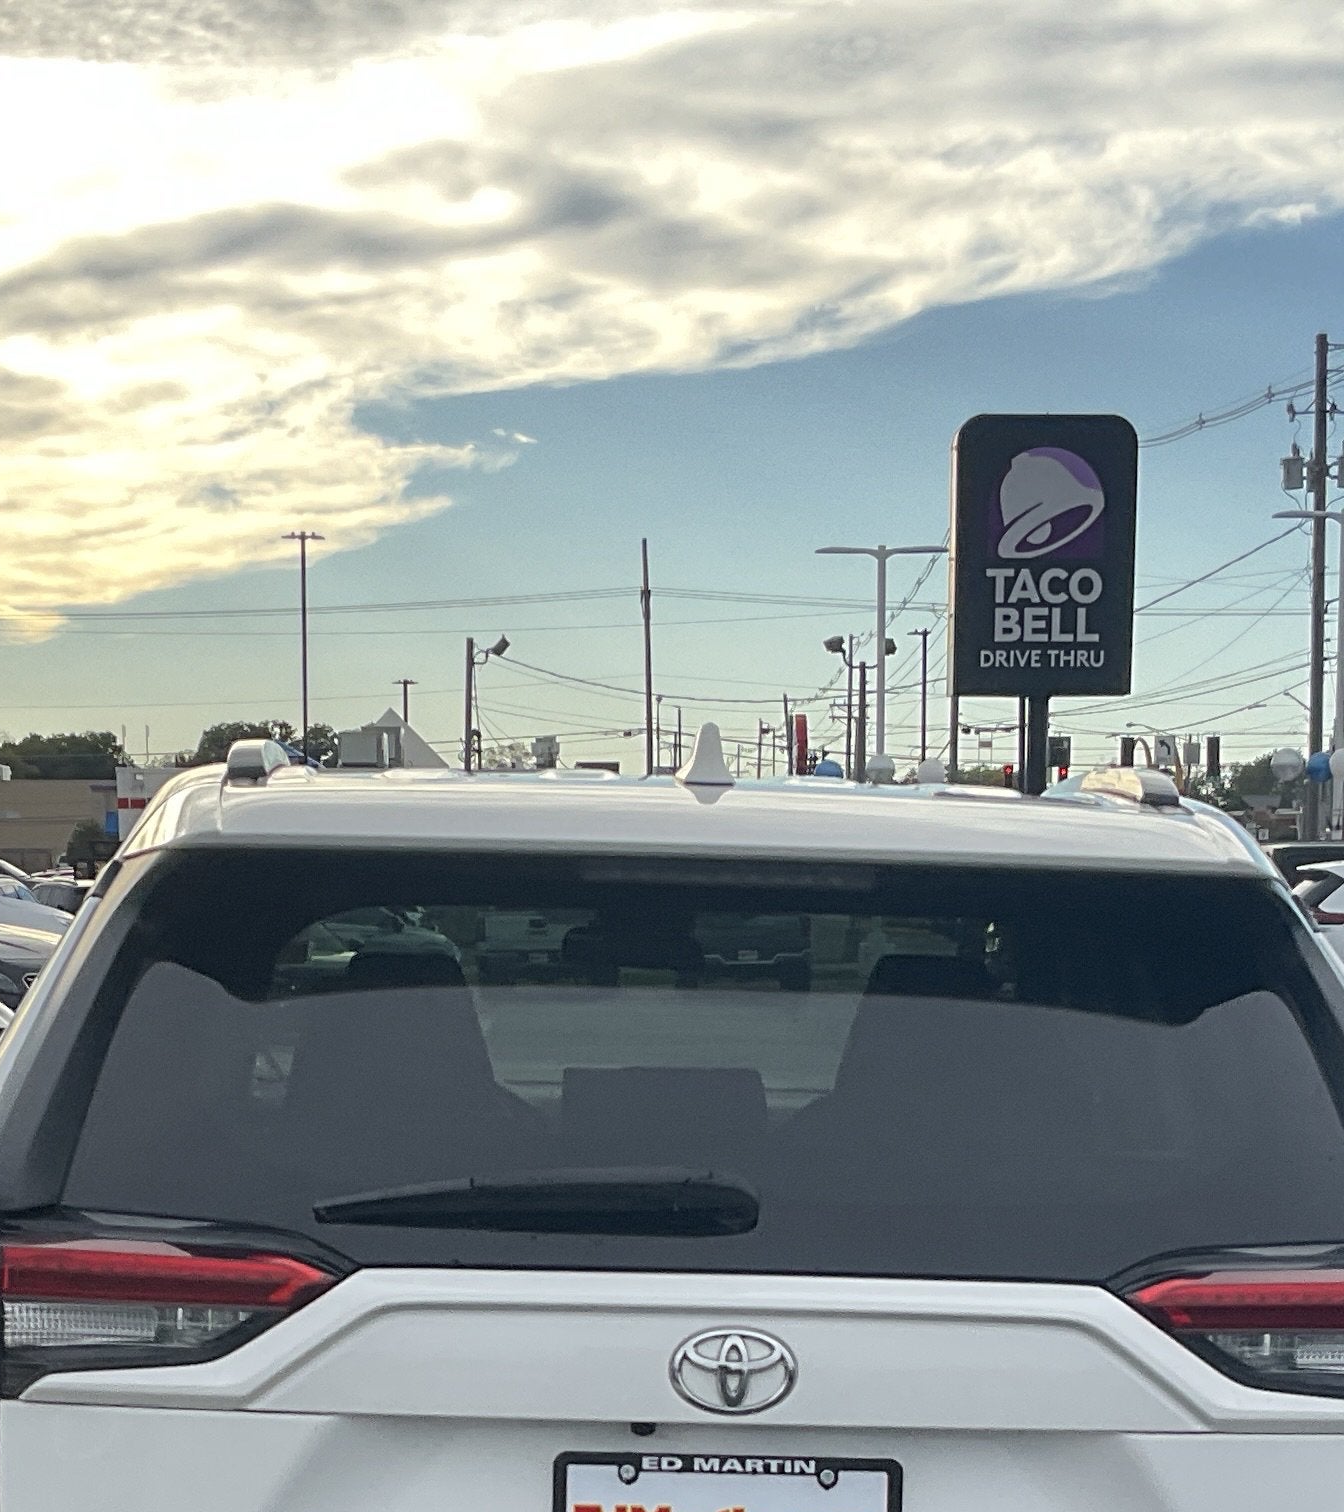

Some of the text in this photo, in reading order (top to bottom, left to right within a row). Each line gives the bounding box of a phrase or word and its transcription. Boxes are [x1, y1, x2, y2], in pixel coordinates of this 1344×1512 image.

[986, 568, 1102, 603] TACO
[994, 607, 1099, 642] BELL
[980, 650, 1104, 667] DRIVE THRU
[641, 1456, 816, 1474] ED MARTIN
